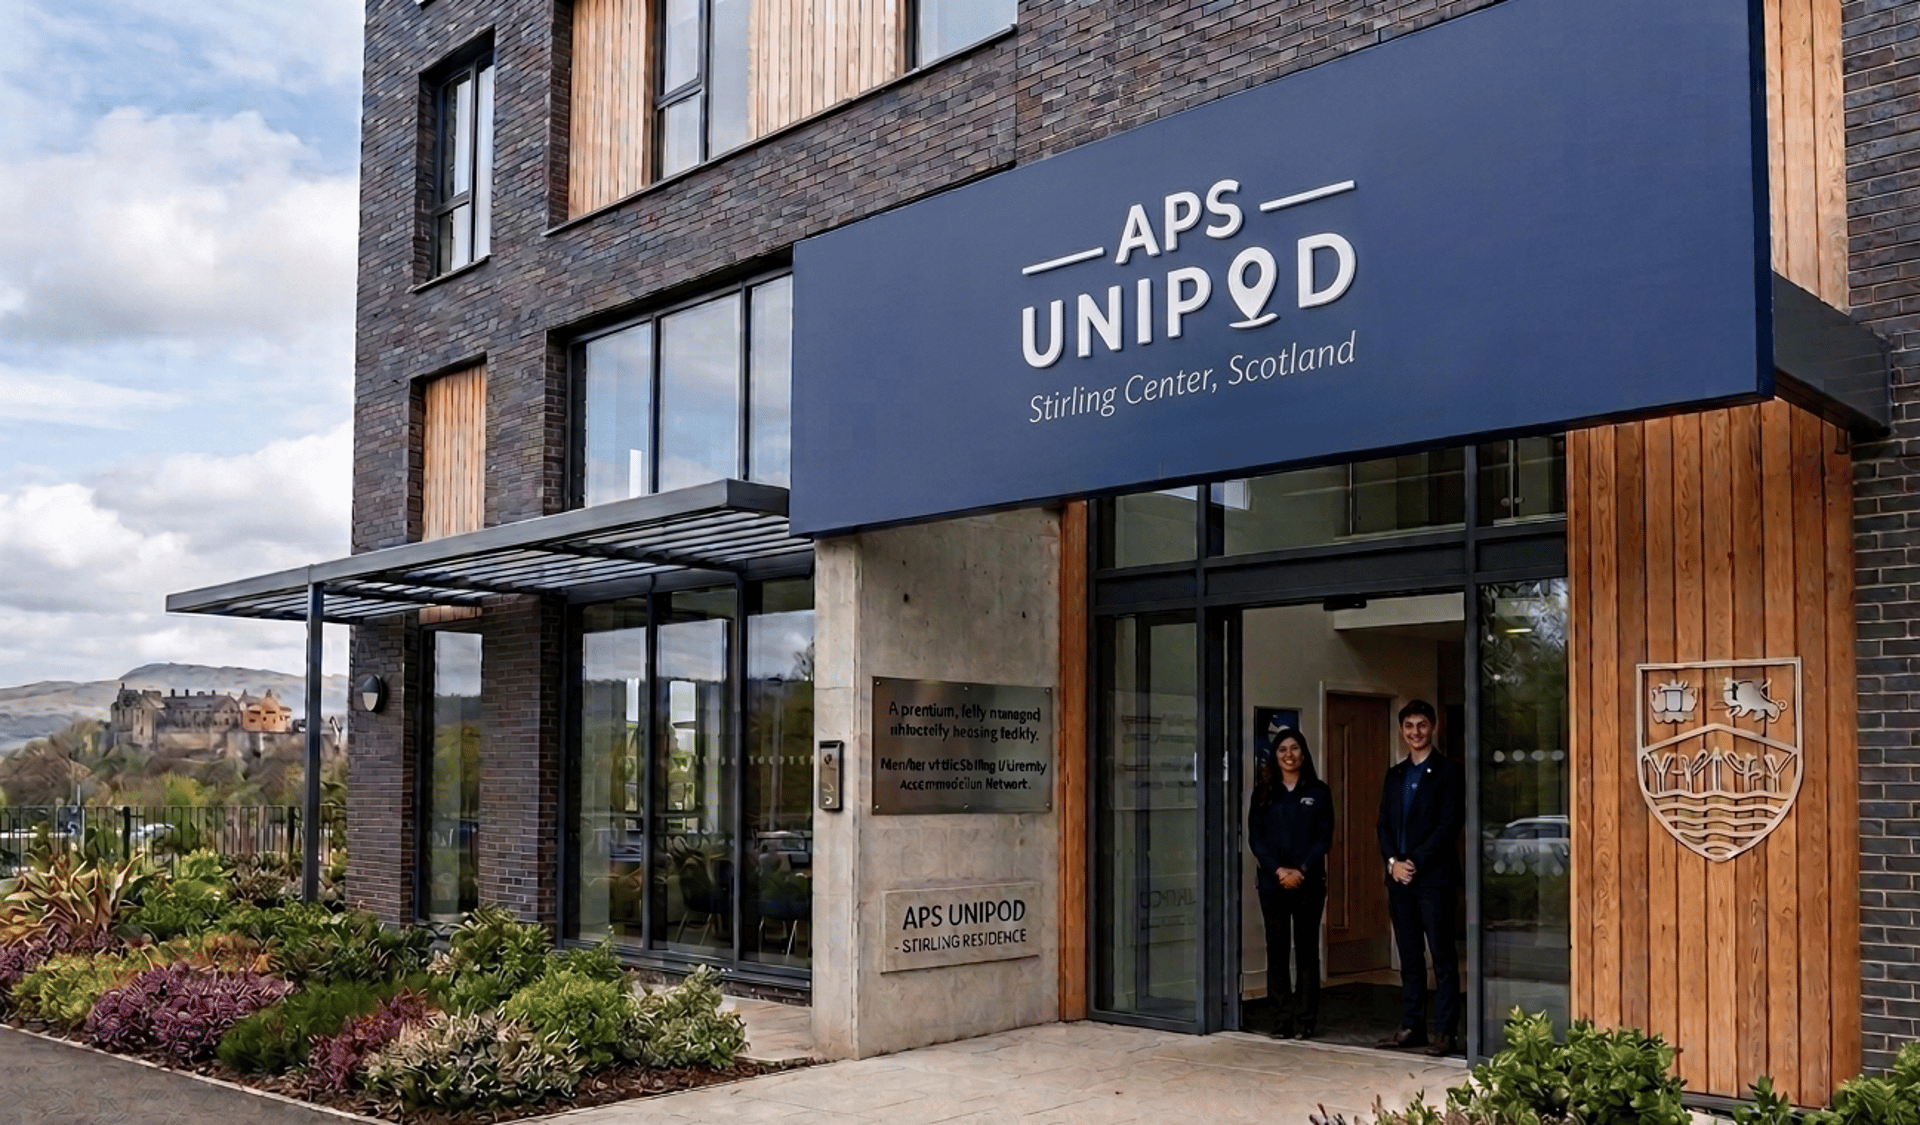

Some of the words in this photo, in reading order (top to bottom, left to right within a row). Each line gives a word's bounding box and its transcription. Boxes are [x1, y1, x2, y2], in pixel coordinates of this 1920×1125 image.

[1115, 179, 1245, 265] APS
[1022, 232, 1357, 369] UNIPOD
[1029, 386, 1117, 423] Stirling
[1124, 365, 1218, 405] Center,
[1228, 330, 1357, 385] Scotland
[889, 701, 899, 716] A
[902, 905, 943, 930] APS
[949, 900, 1026, 926] UNIPOD
[902, 935, 960, 953] STIRLING
